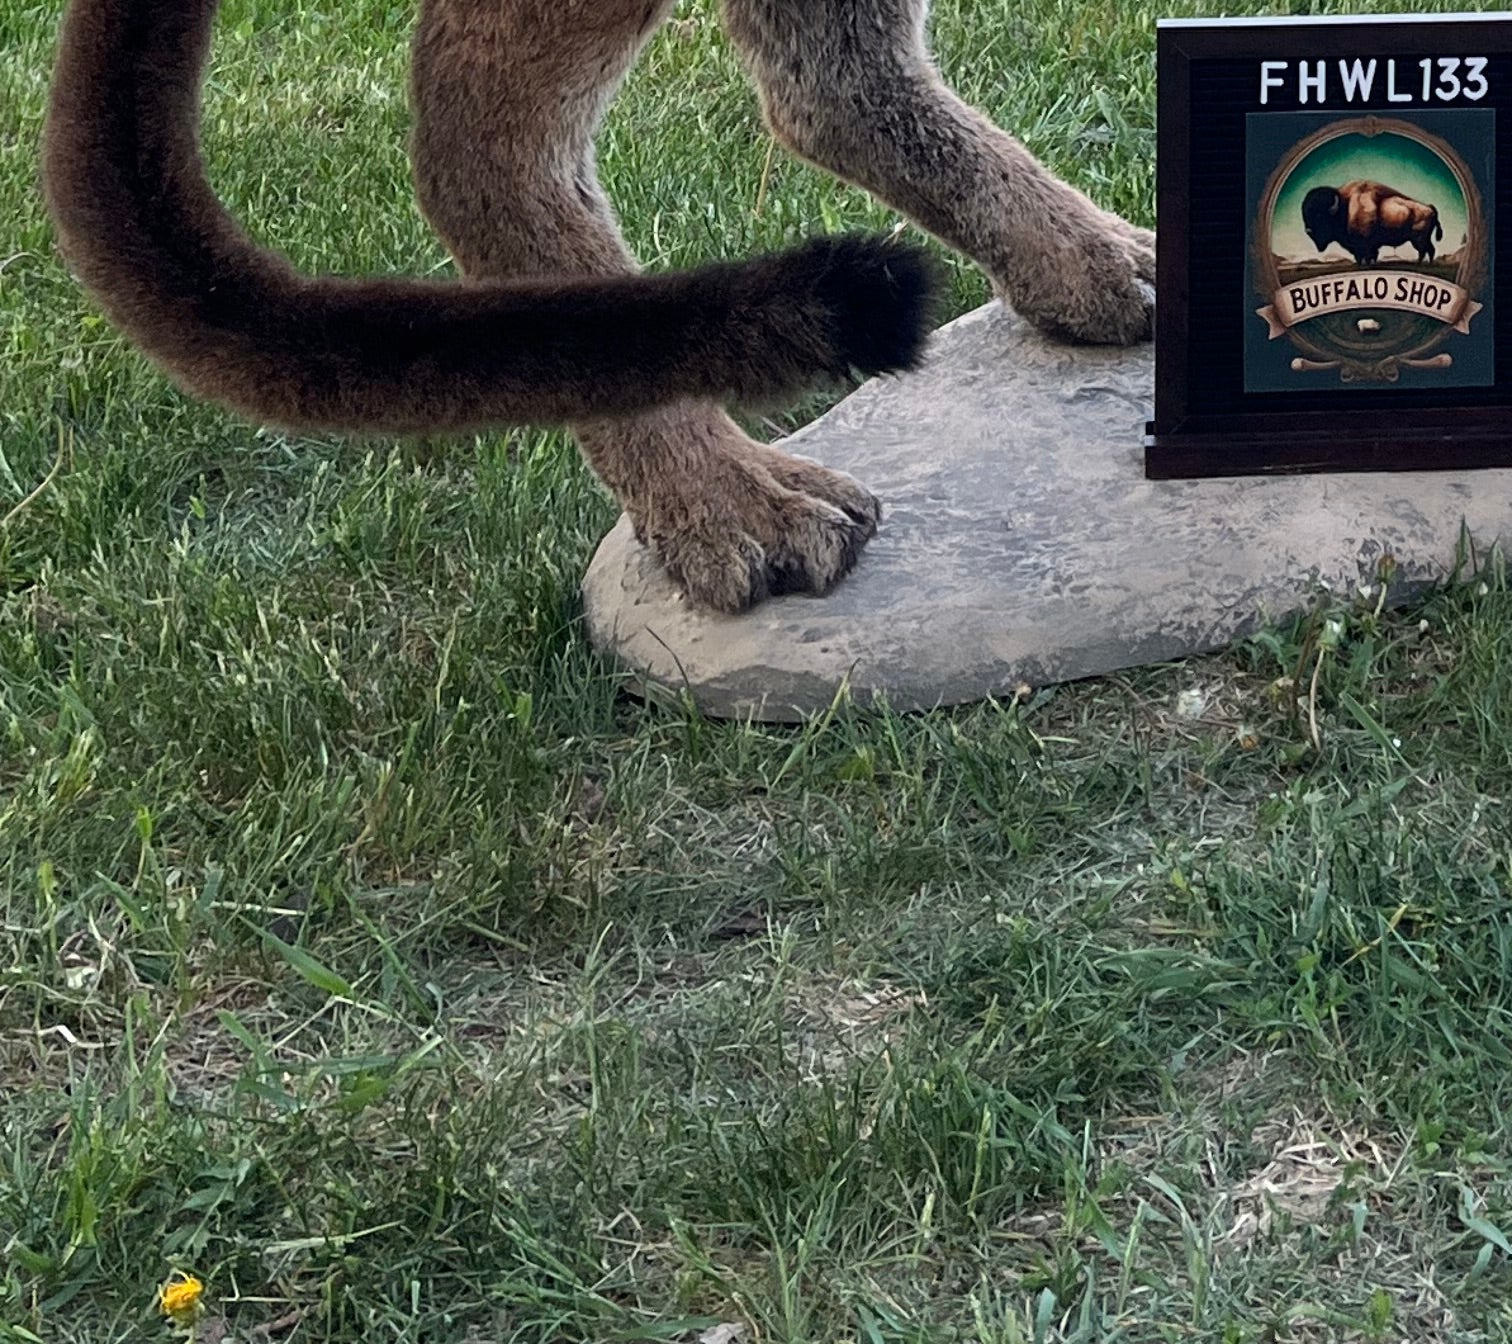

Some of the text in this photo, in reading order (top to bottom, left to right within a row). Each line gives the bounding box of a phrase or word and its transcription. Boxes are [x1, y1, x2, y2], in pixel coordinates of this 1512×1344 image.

[1259, 56, 1489, 104] FHWL133
[1290, 276, 1452, 314] BUFFALO SHOP
